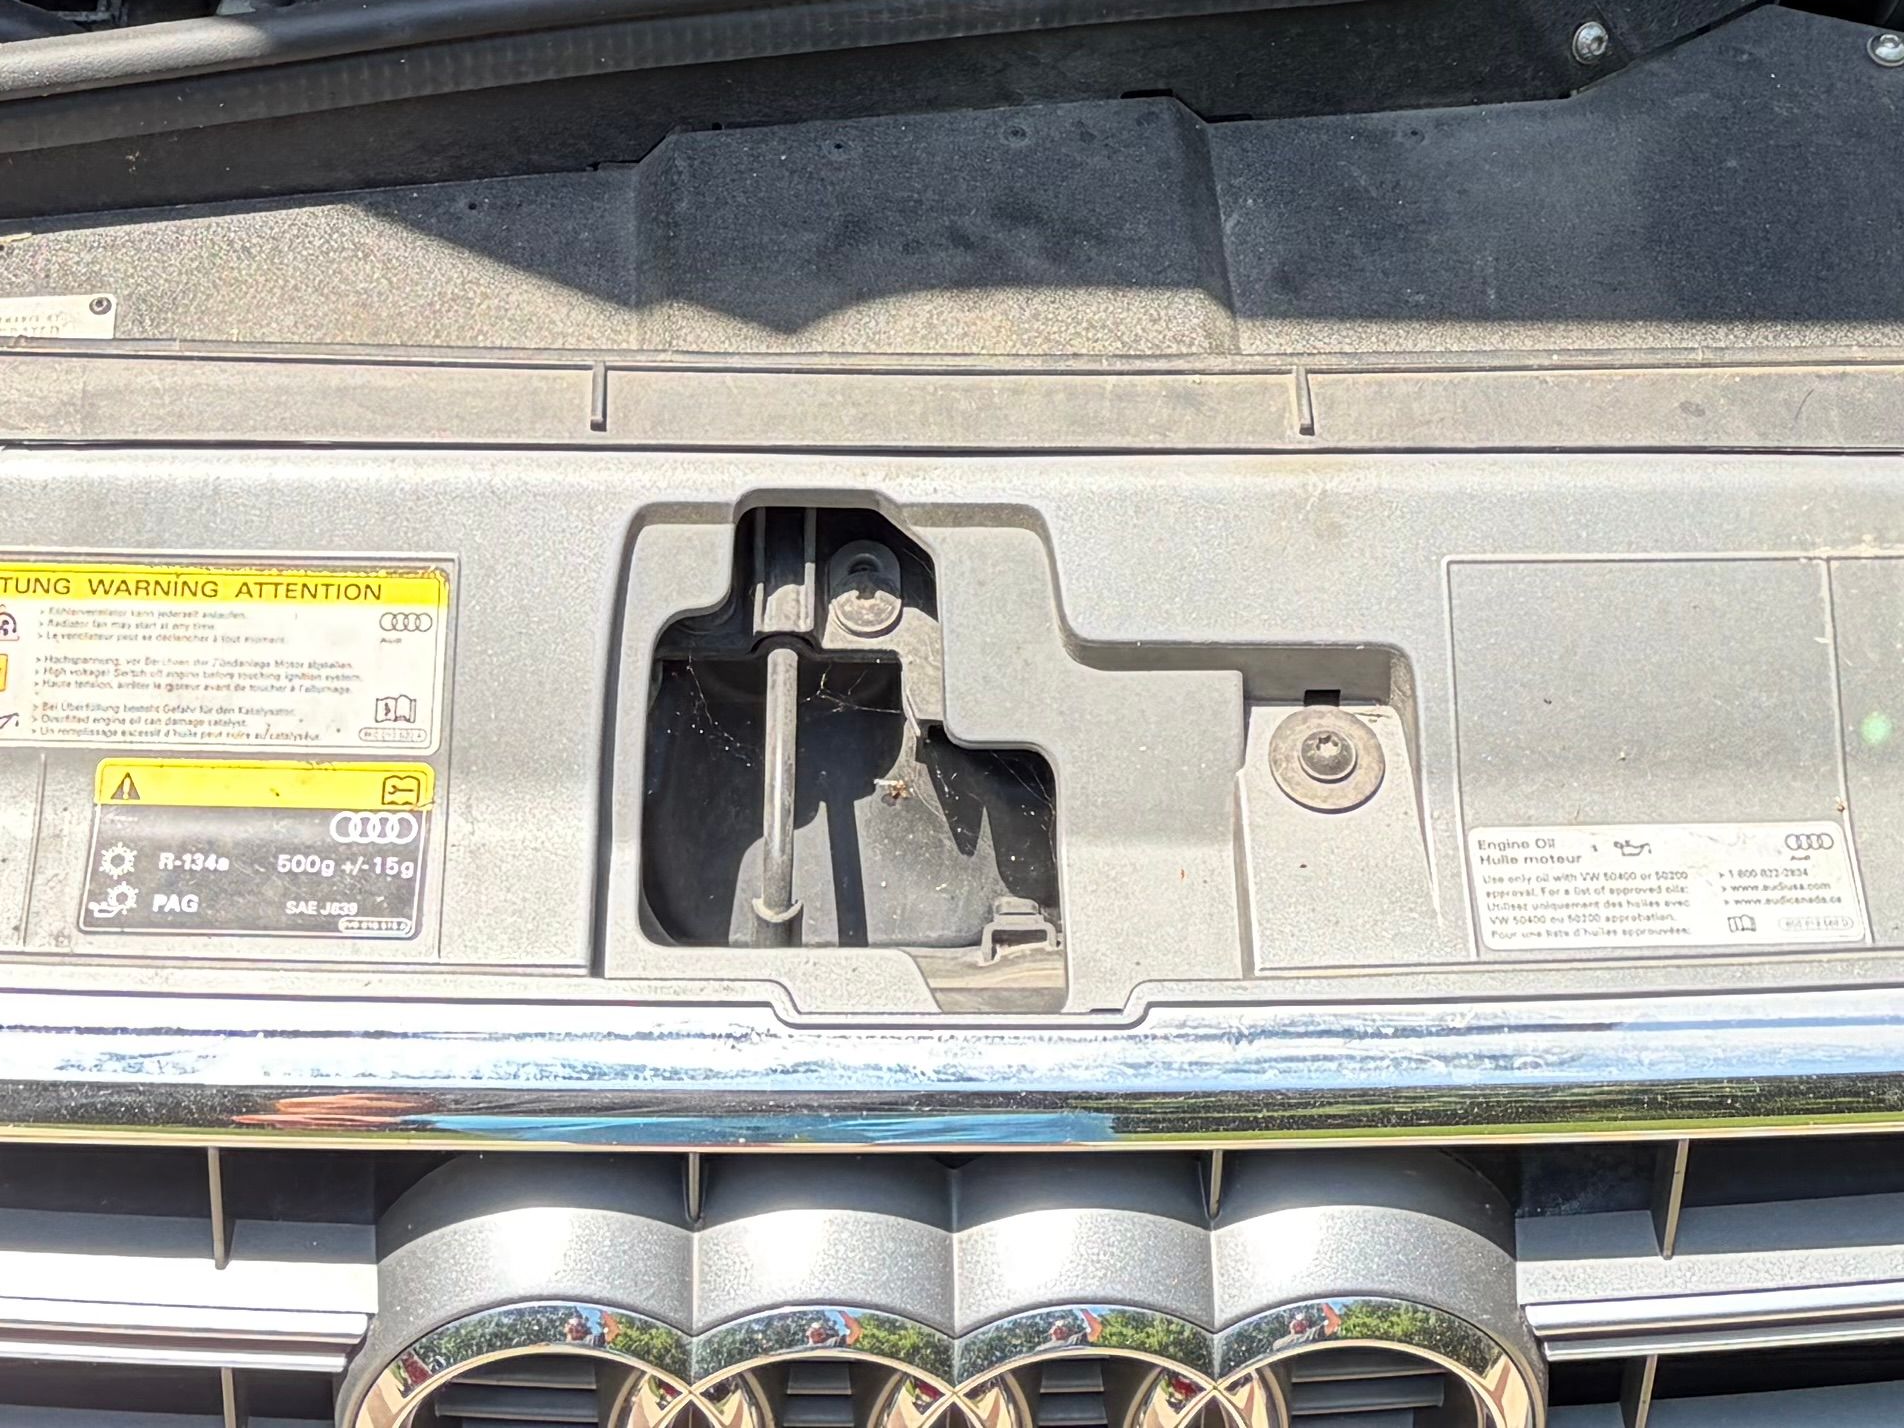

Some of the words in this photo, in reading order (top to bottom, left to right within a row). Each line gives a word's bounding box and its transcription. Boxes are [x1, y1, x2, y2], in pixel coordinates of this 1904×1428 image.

[88, 578, 218, 597] WARNING
[236, 581, 381, 600] ATTENTION
[215, 705, 235, 715] den
[1477, 839, 1529, 851] Engine
[1534, 837, 1555, 849] Oil
[158, 851, 229, 871] R-134a
[277, 853, 335, 877] 500g
[1479, 854, 1518, 865] Huile
[1523, 854, 1581, 864] moteur
[1579, 871, 1600, 882] VW
[1540, 886, 1560, 896] For
[152, 893, 198, 912] PAG
[285, 900, 317, 914] SAE
[1489, 916, 1509, 925] VW
